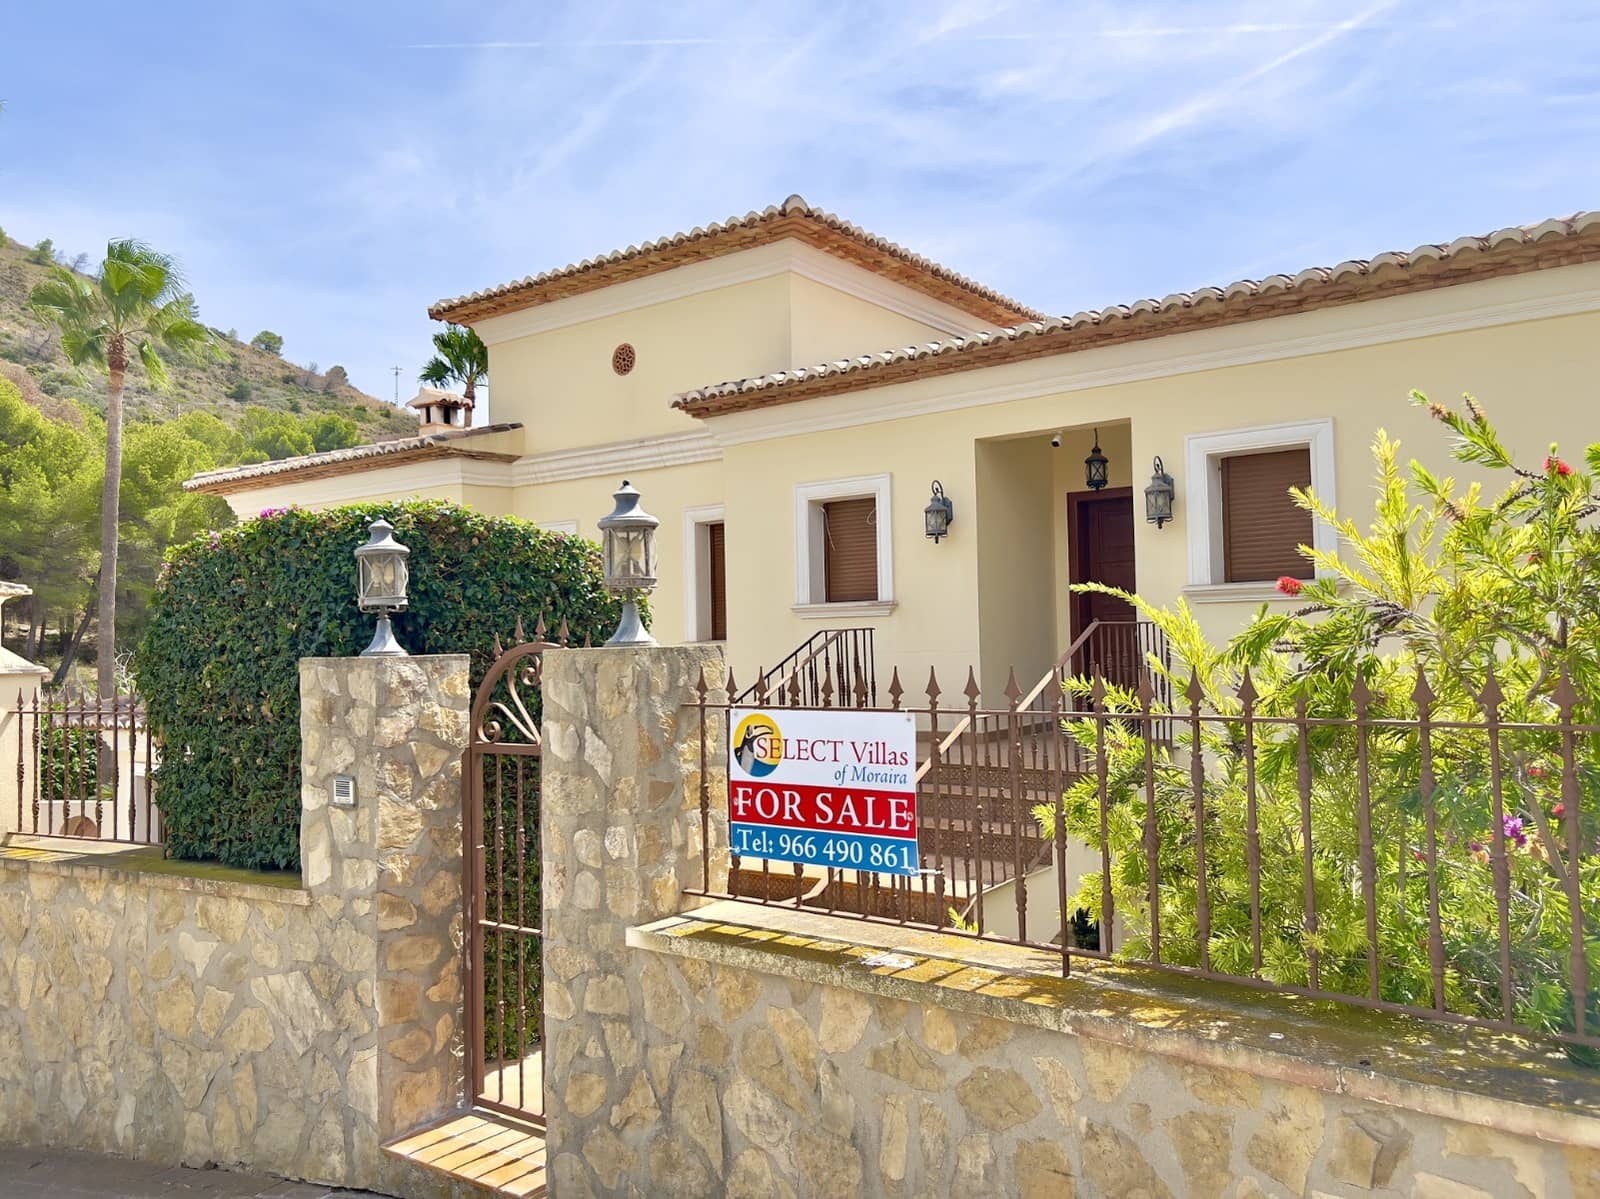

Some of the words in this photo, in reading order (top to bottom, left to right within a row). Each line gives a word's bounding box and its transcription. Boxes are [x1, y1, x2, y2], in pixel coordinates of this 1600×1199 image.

[756, 737, 843, 762] SELECT
[850, 741, 909, 766] Villas
[834, 764, 848, 786] of
[850, 766, 908, 784] Moraira
[736, 787, 805, 822] FOR
[815, 792, 910, 831] SALE
[736, 828, 773, 854] Tel:
[779, 834, 817, 858] 966
[823, 839, 863, 864] 490
[870, 844, 910, 869] 861
